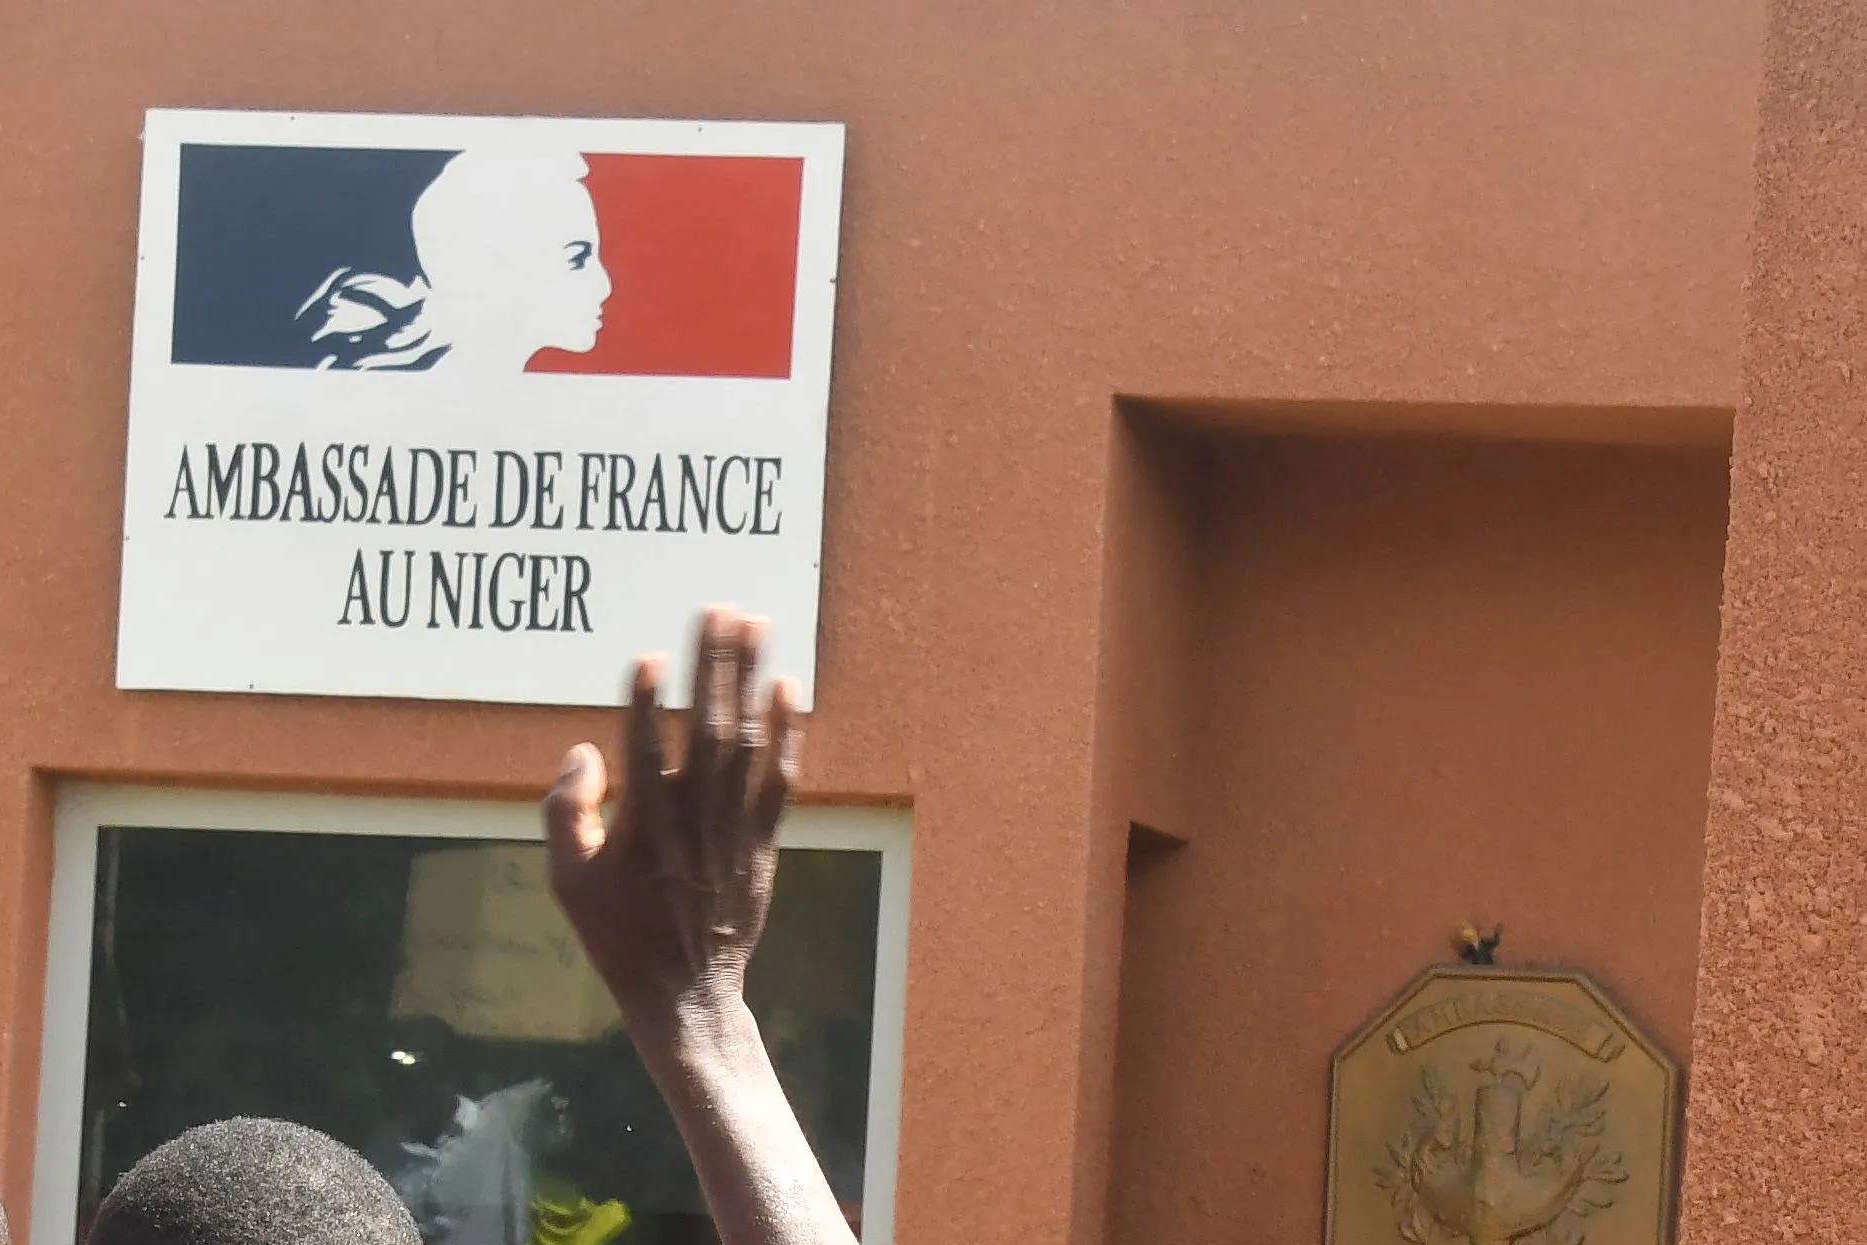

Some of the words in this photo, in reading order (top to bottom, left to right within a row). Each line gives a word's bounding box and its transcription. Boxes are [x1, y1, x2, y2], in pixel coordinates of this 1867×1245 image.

[164, 442, 478, 530] AMBASSADE
[488, 450, 565, 531] DE
[576, 453, 783, 536] FRANCE
[337, 548, 415, 629] AU
[427, 551, 594, 634] NIGER
